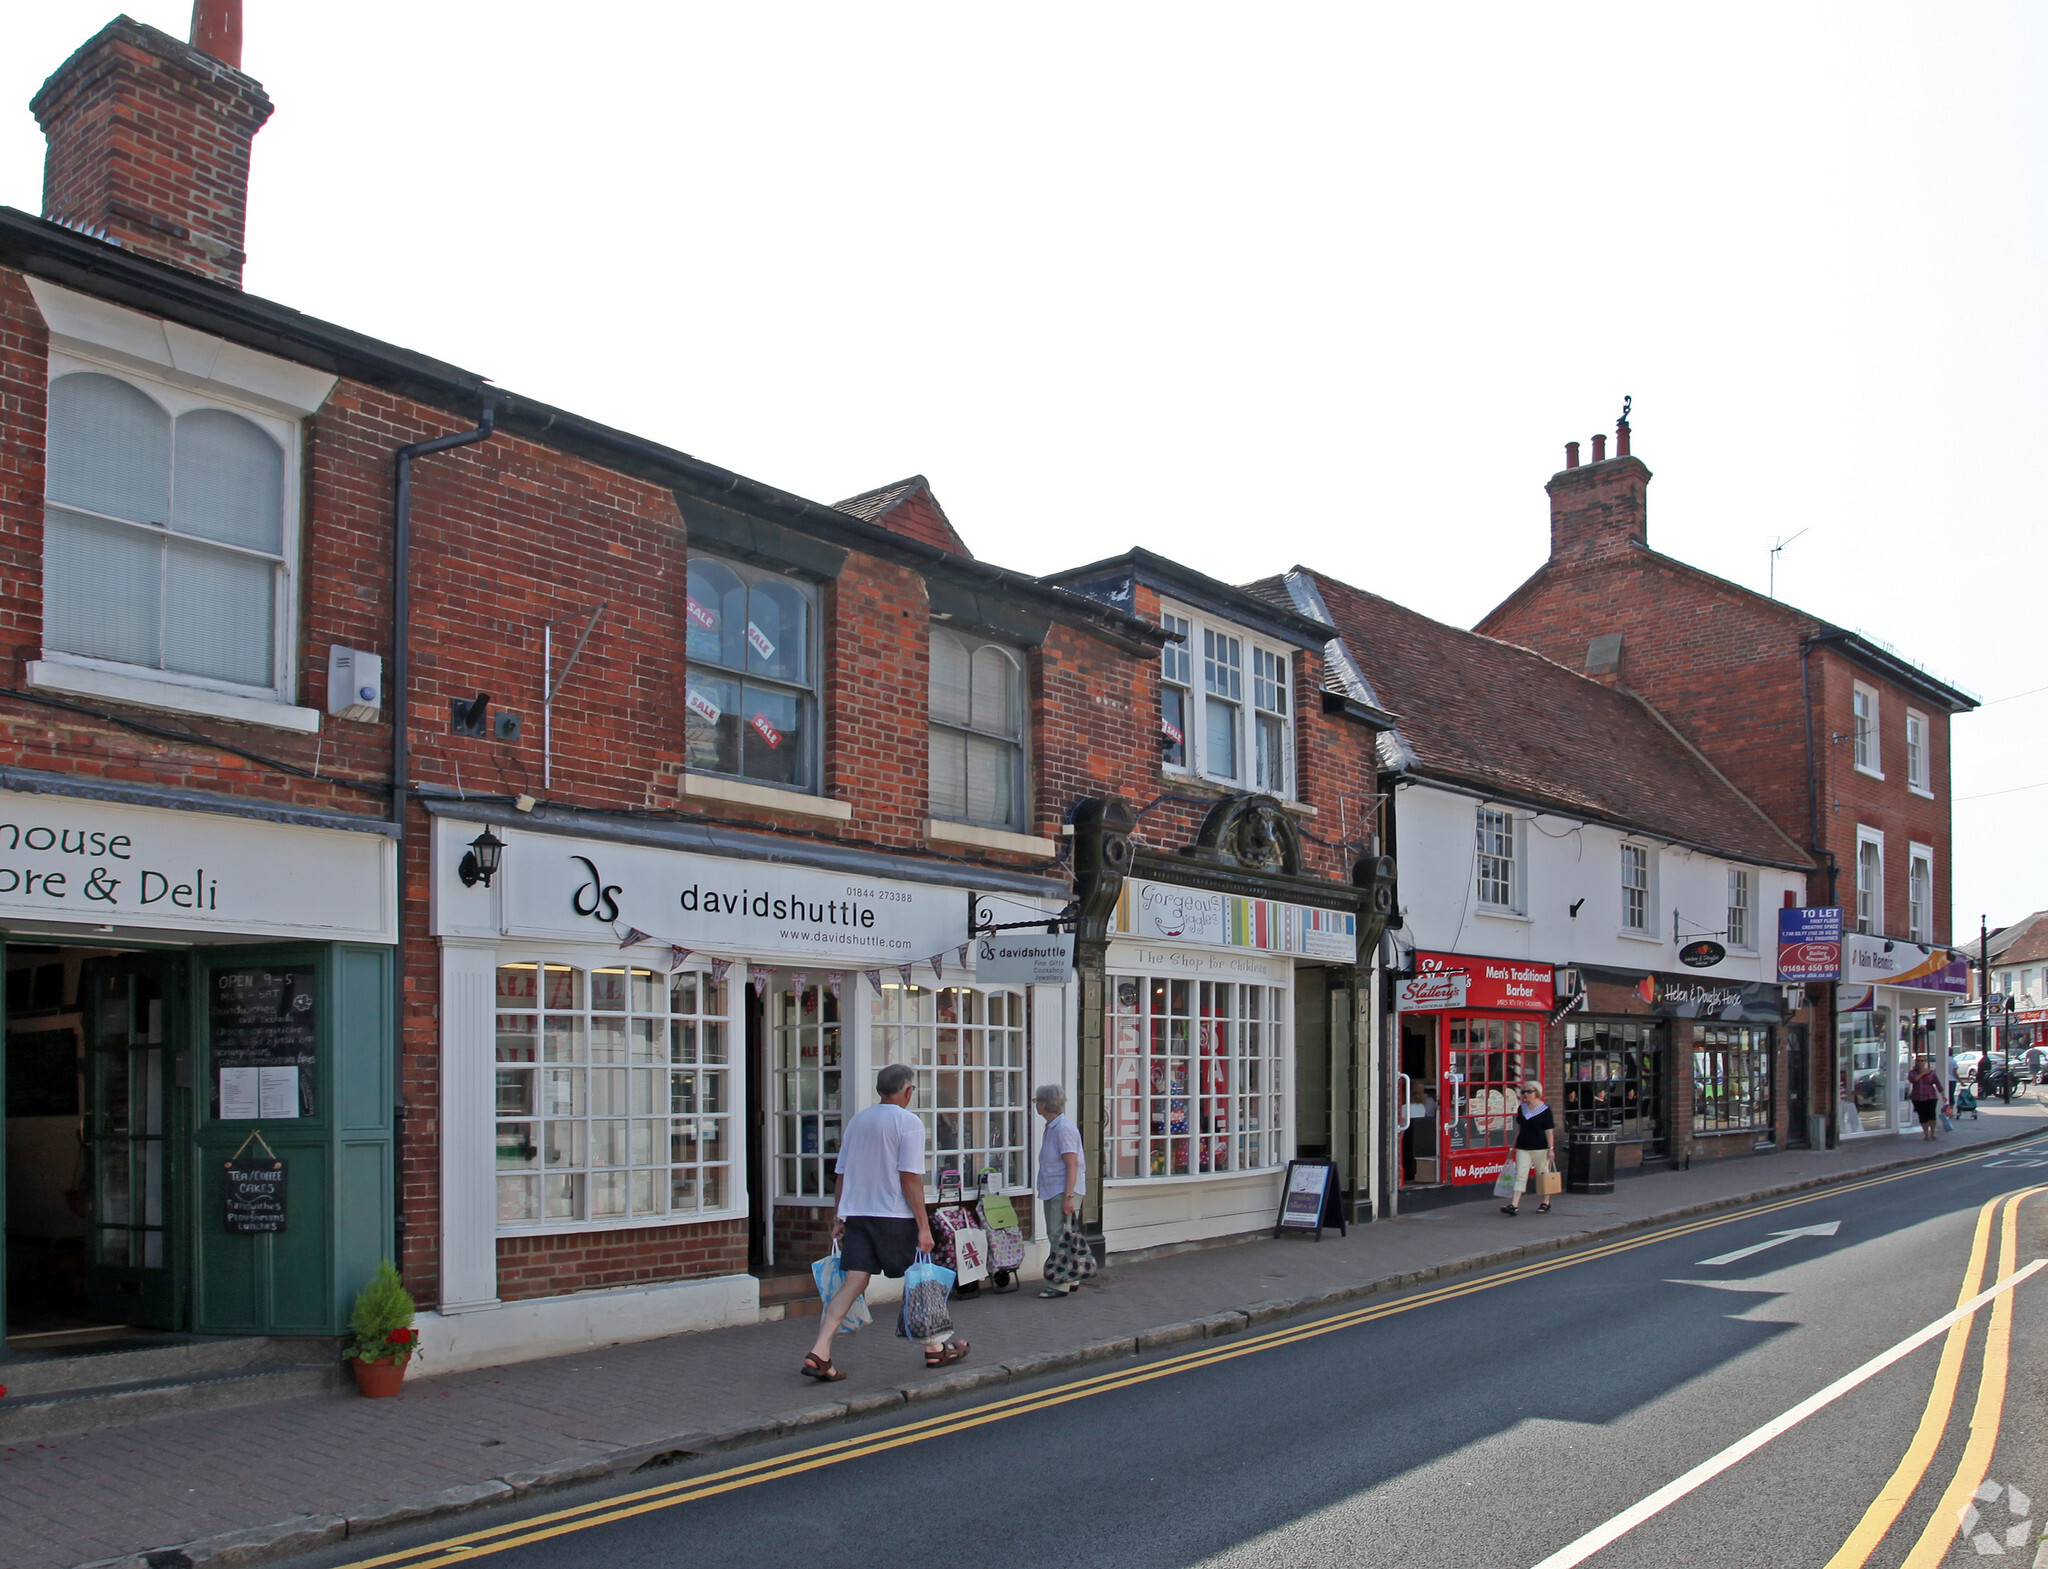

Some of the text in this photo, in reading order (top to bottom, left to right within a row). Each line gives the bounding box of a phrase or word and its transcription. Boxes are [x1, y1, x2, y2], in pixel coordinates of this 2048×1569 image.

[687, 601, 714, 628] SALE
[748, 628, 770, 653] SALE
[690, 697, 716, 719] SALE
[755, 718, 778, 744] SALE
[84, 867, 121, 905] &
[140, 869, 218, 911] Deli
[846, 886, 912, 903] 01844 273388
[680, 884, 876, 929] davidshuttle
[1141, 884, 1221, 912] Gorgeous
[1801, 908, 1839, 918] TO LET
[780, 929, 912, 950] www.davidshuttle.com
[999, 947, 1066, 958] davidshuttle
[1859, 950, 1894, 971] Iain Rennie
[1134, 949, 1164, 964] The
[1170, 952, 1203, 971] Shop
[1230, 959, 1267, 975] Children
[1782, 964, 1806, 972] 01494
[1807, 964, 1822, 972] 450
[1033, 967, 1064, 975] Cookshop
[1486, 966, 1552, 983] Men's Traditional
[218, 975, 253, 989] OPEN
[1506, 983, 1534, 997] Barber
[1402, 982, 1460, 1001] Slattery's
[1664, 983, 1688, 1002] Helen
[1722, 989, 1742, 1006] House
[1454, 1166, 1466, 1178] No
[239, 1183, 275, 1194] CAKES
[226, 1199, 281, 1210] Sandwiches
[227, 1212, 285, 1223] Ploughmans
[237, 1222, 278, 1231] Lunches
